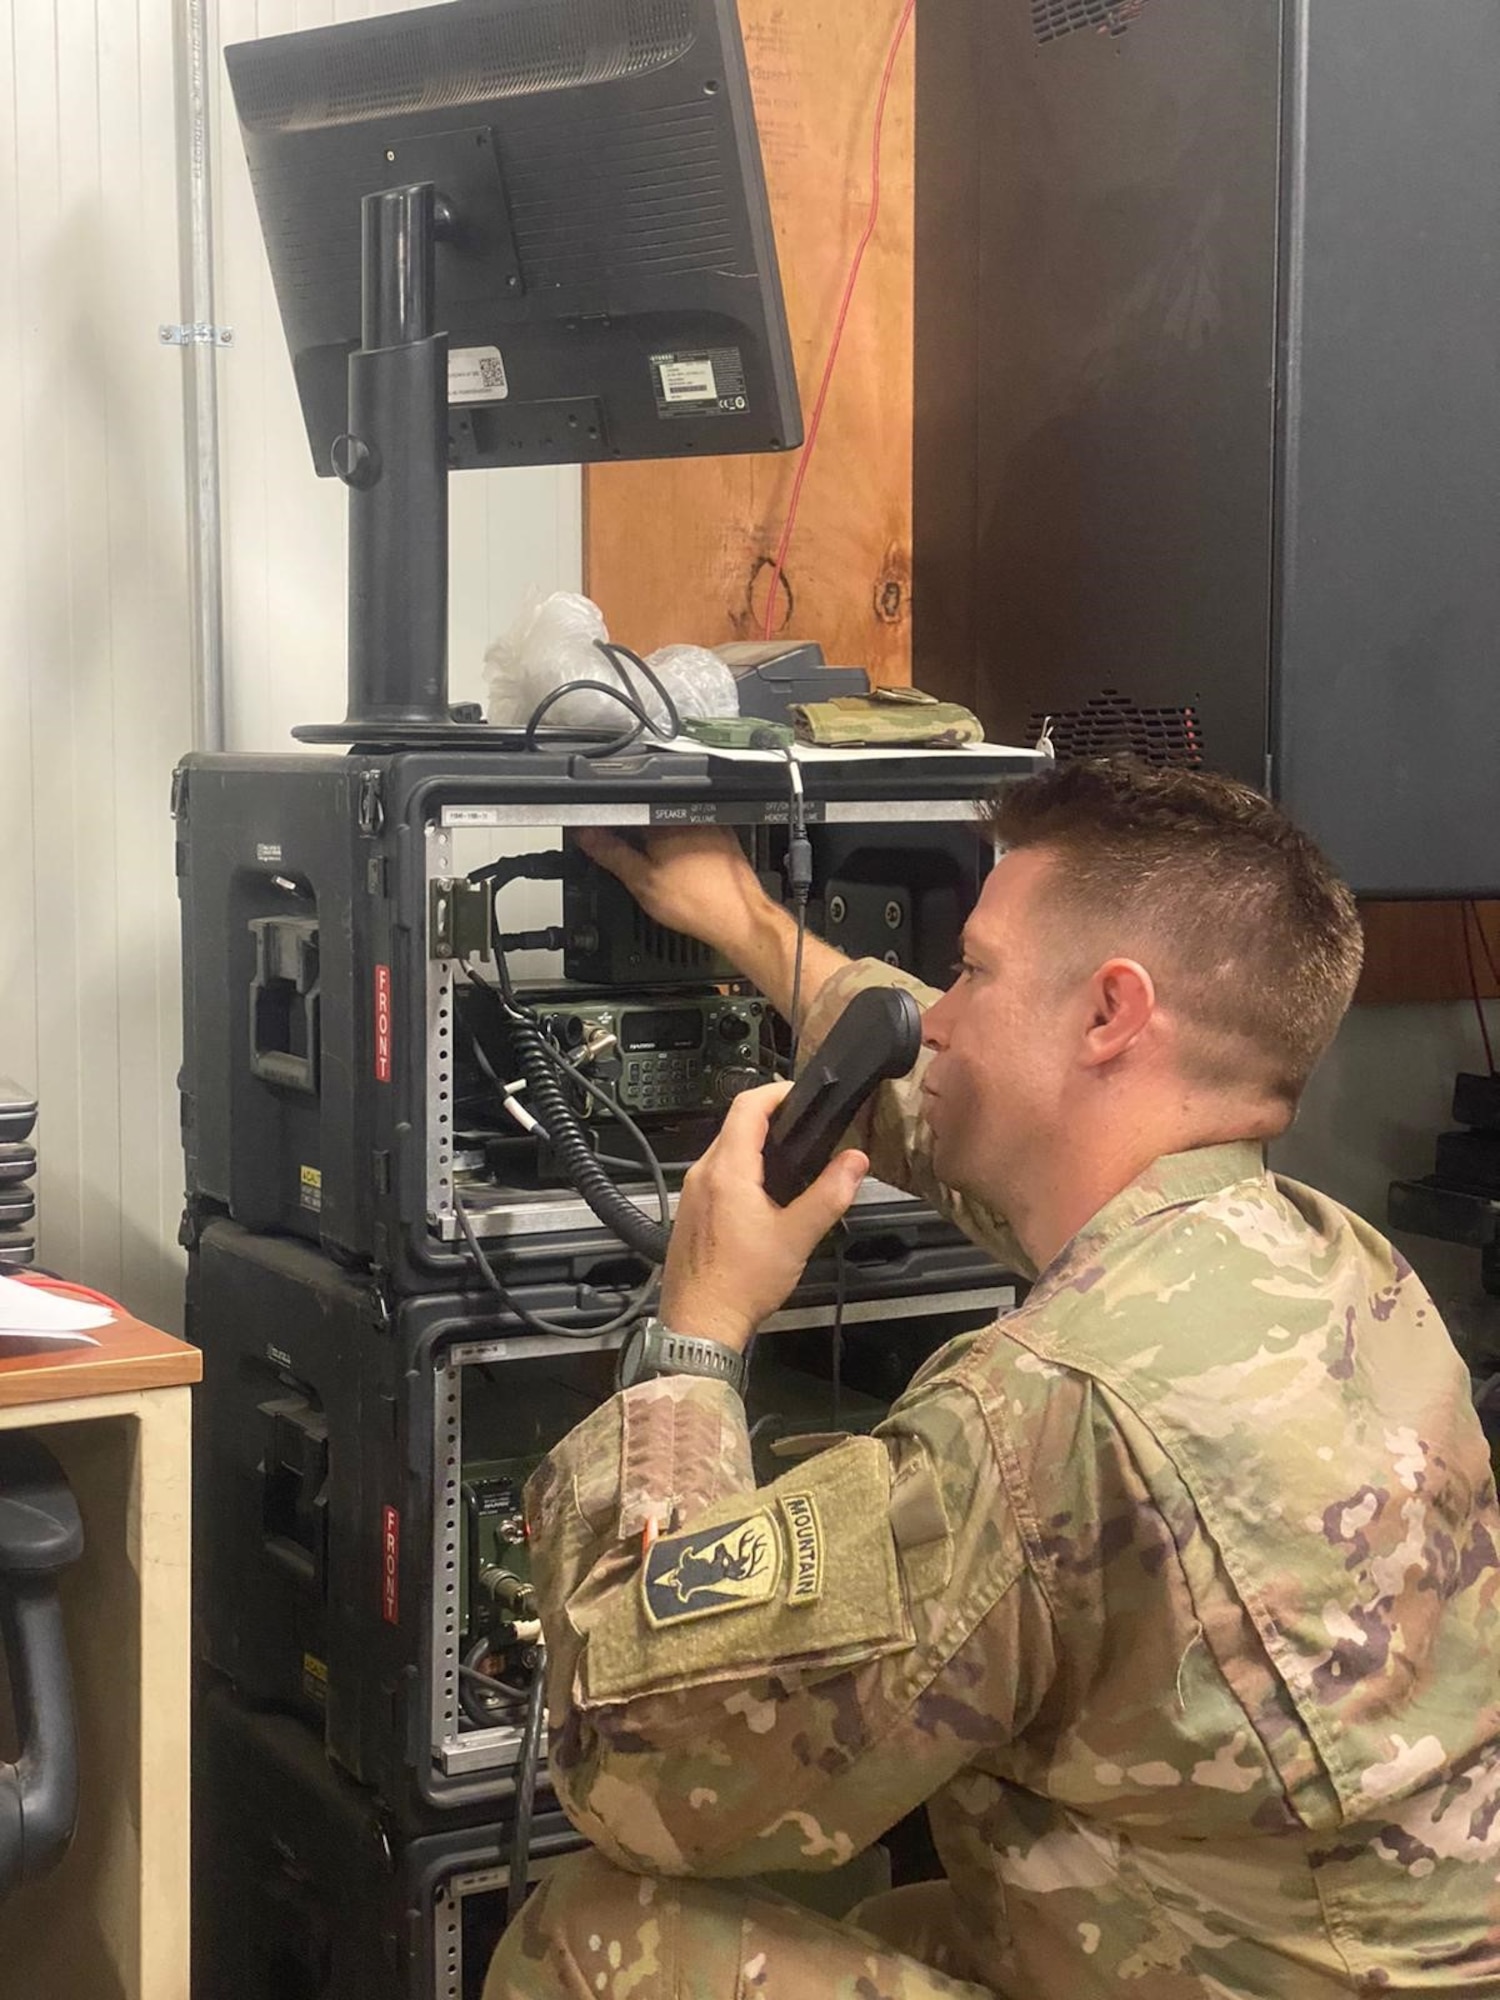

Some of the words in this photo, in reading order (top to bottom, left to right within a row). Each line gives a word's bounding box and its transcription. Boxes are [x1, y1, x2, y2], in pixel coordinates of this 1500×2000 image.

[655, 809, 687, 819] SPEAKER
[379, 970, 388, 1078] FRONT
[386, 1511, 395, 1617] FRONT
[787, 1499, 816, 1594] MOUNTAIN
